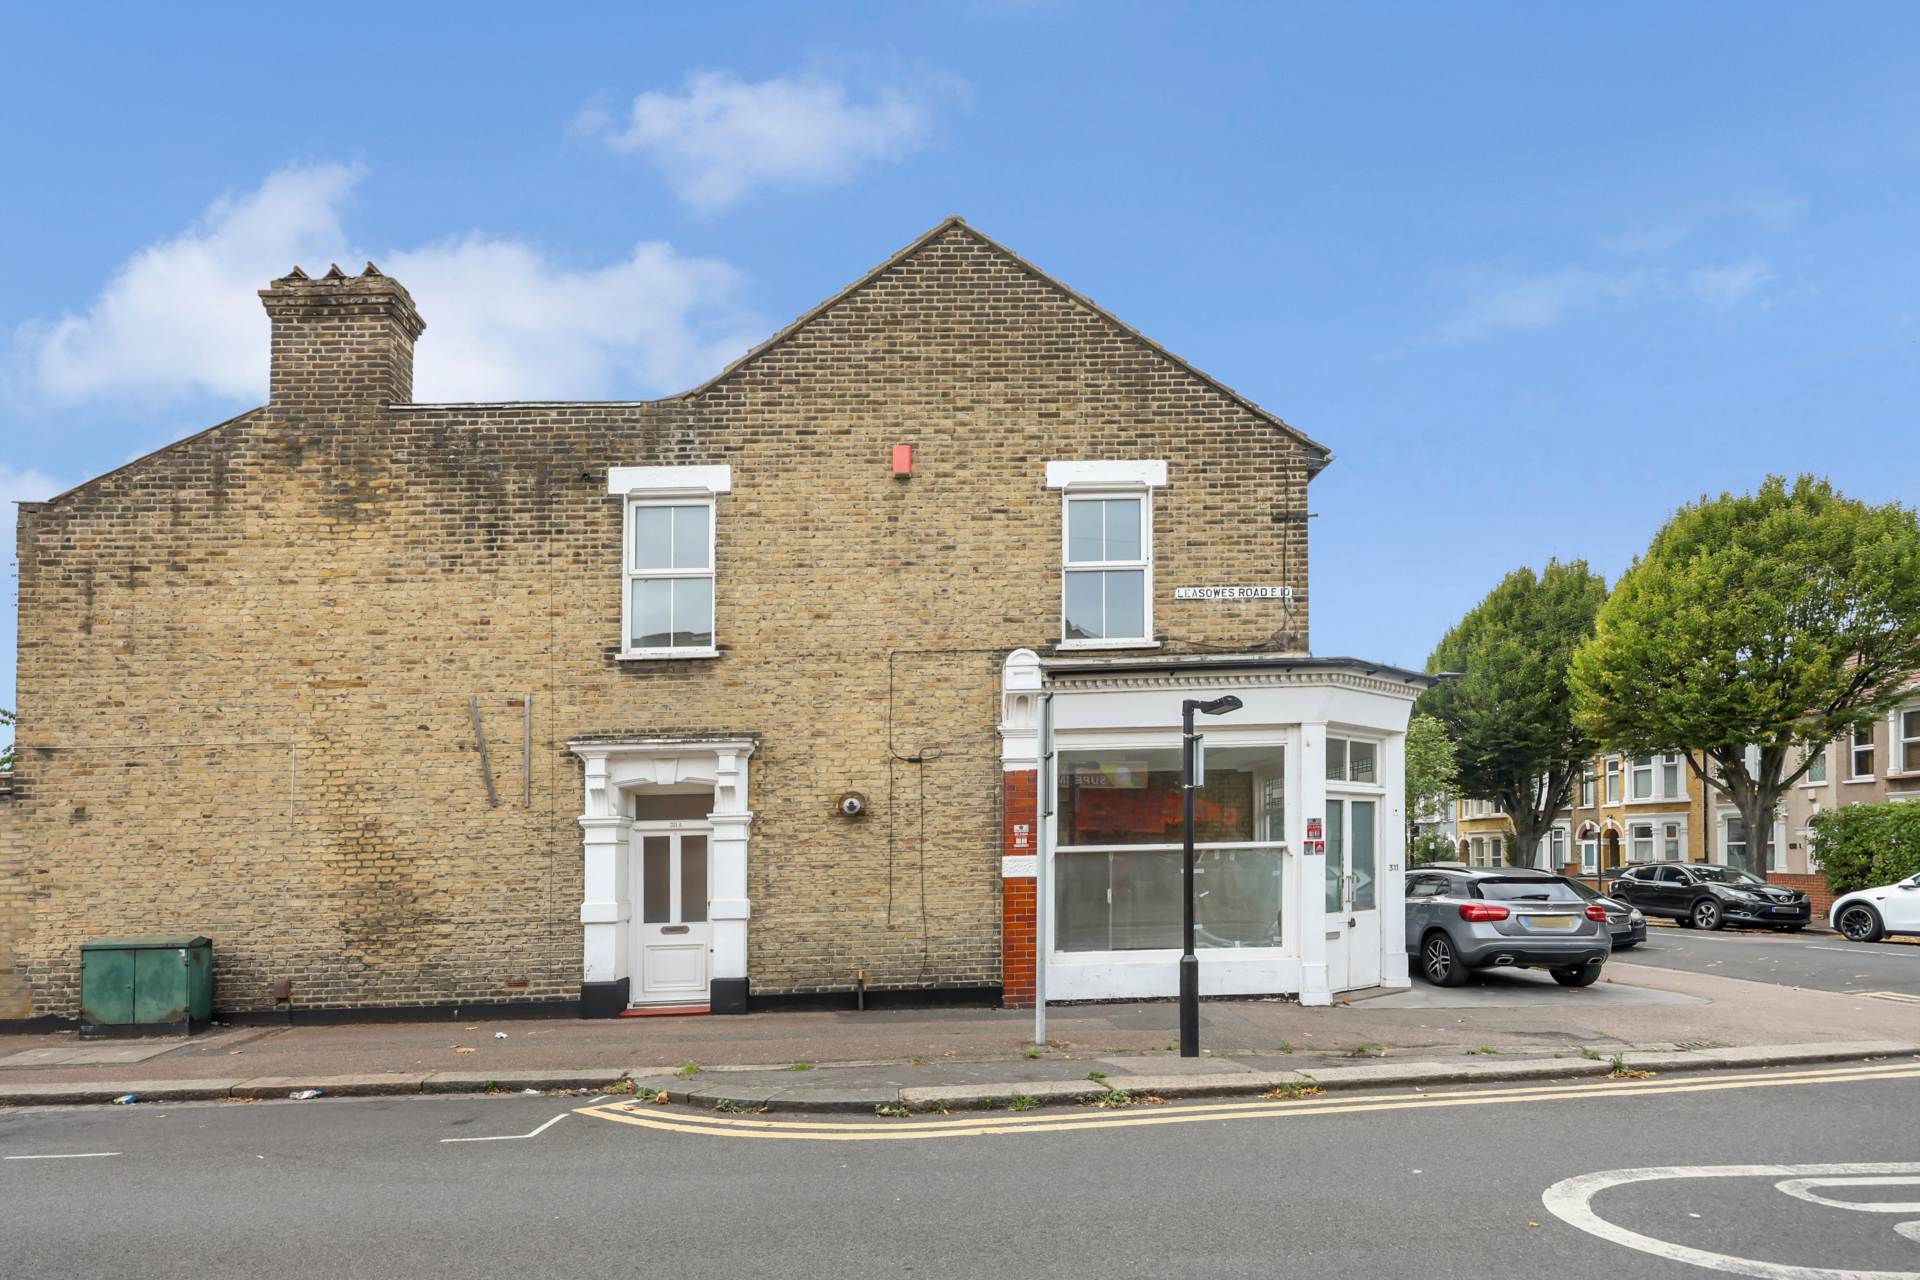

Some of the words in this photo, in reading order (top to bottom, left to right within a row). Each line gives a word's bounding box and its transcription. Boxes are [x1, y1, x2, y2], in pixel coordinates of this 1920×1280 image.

[1177, 588, 1235, 598] LEASOWES
[1238, 588, 1268, 597] ROAD
[1388, 863, 1399, 871] 311
